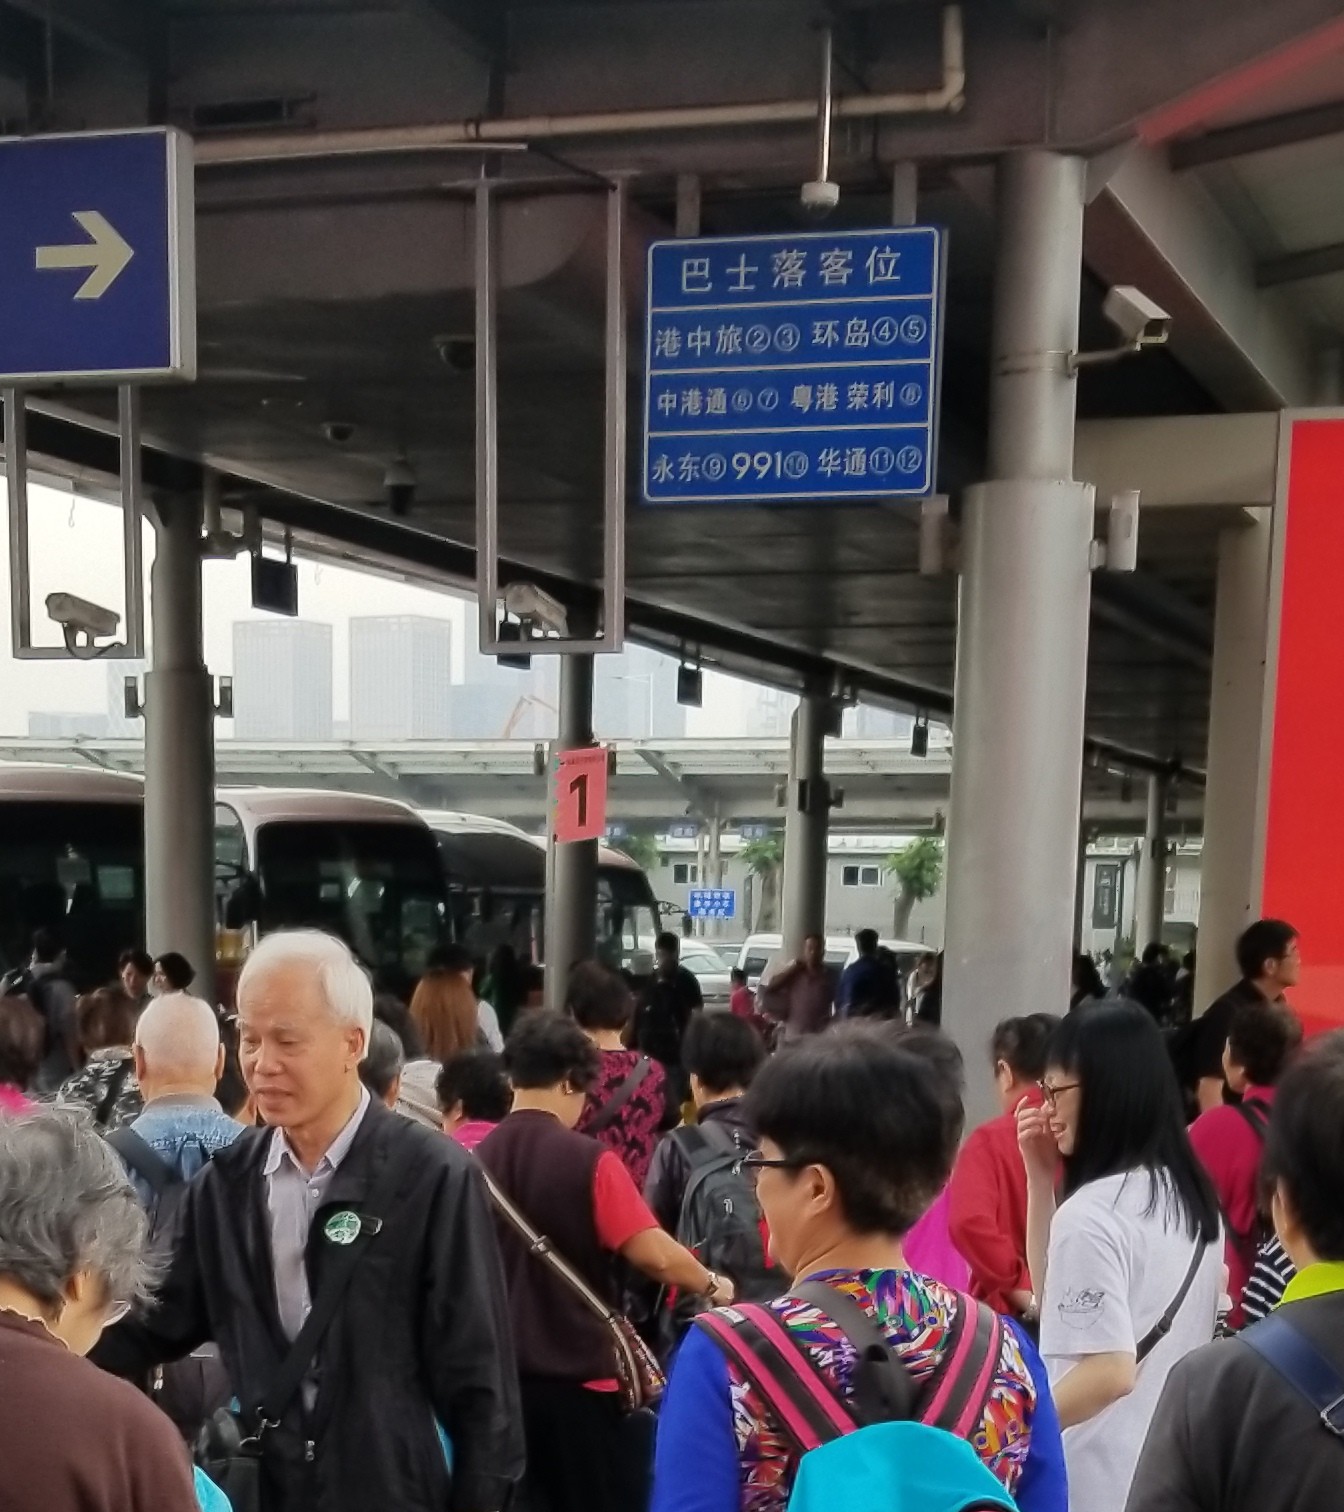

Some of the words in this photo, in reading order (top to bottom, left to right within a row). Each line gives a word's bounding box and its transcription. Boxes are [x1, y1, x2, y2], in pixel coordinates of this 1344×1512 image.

[681, 245, 901, 294] 巴士落客位
[569, 773, 589, 828] 1
